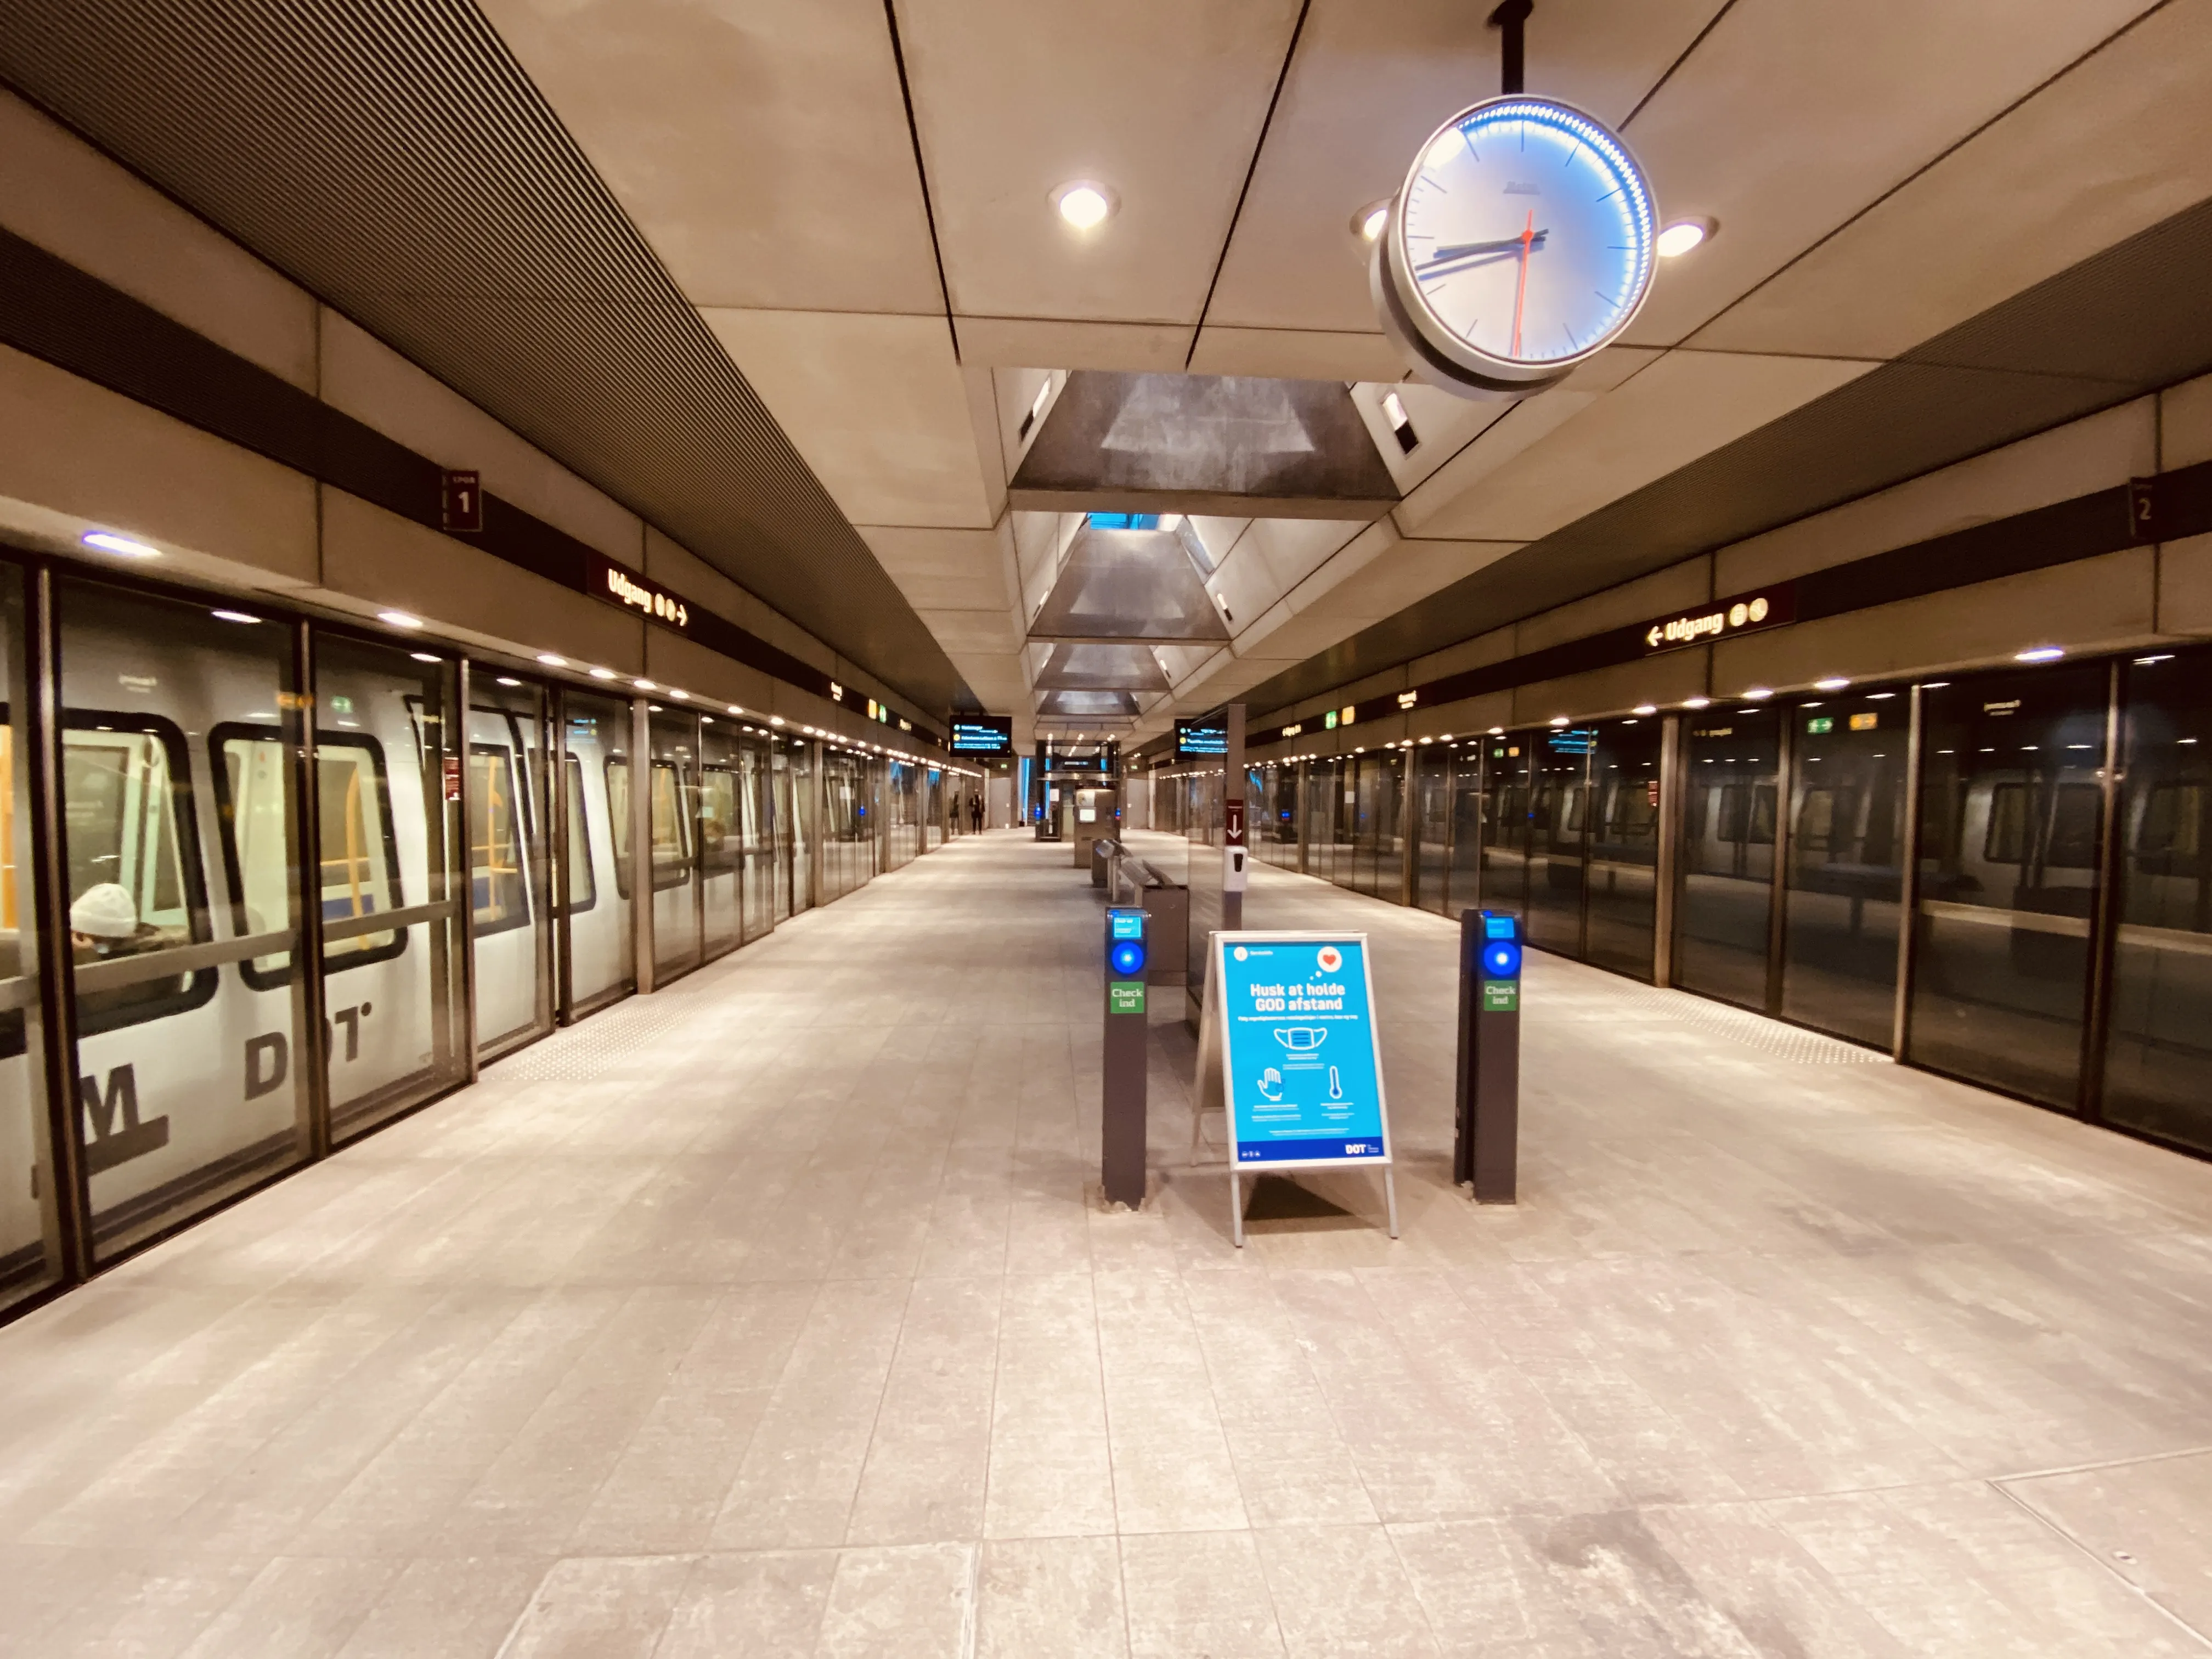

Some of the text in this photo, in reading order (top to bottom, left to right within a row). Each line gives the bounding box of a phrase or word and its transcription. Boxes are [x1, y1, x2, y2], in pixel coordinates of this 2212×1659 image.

[459, 492, 470, 513] 1
[2139, 498, 2151, 520] 2
[608, 568, 652, 613] Udgang
[1665, 613, 1725, 641] Udgang
[1111, 989, 1143, 997] Check
[1250, 983, 1346, 996] Husk at holde
[1486, 986, 1516, 995] Check
[1119, 999, 1136, 1007] ind
[1255, 997, 1343, 1012] GOD afstand
[1492, 996, 1508, 1005] ind
[1345, 1144, 1367, 1154] DOT
